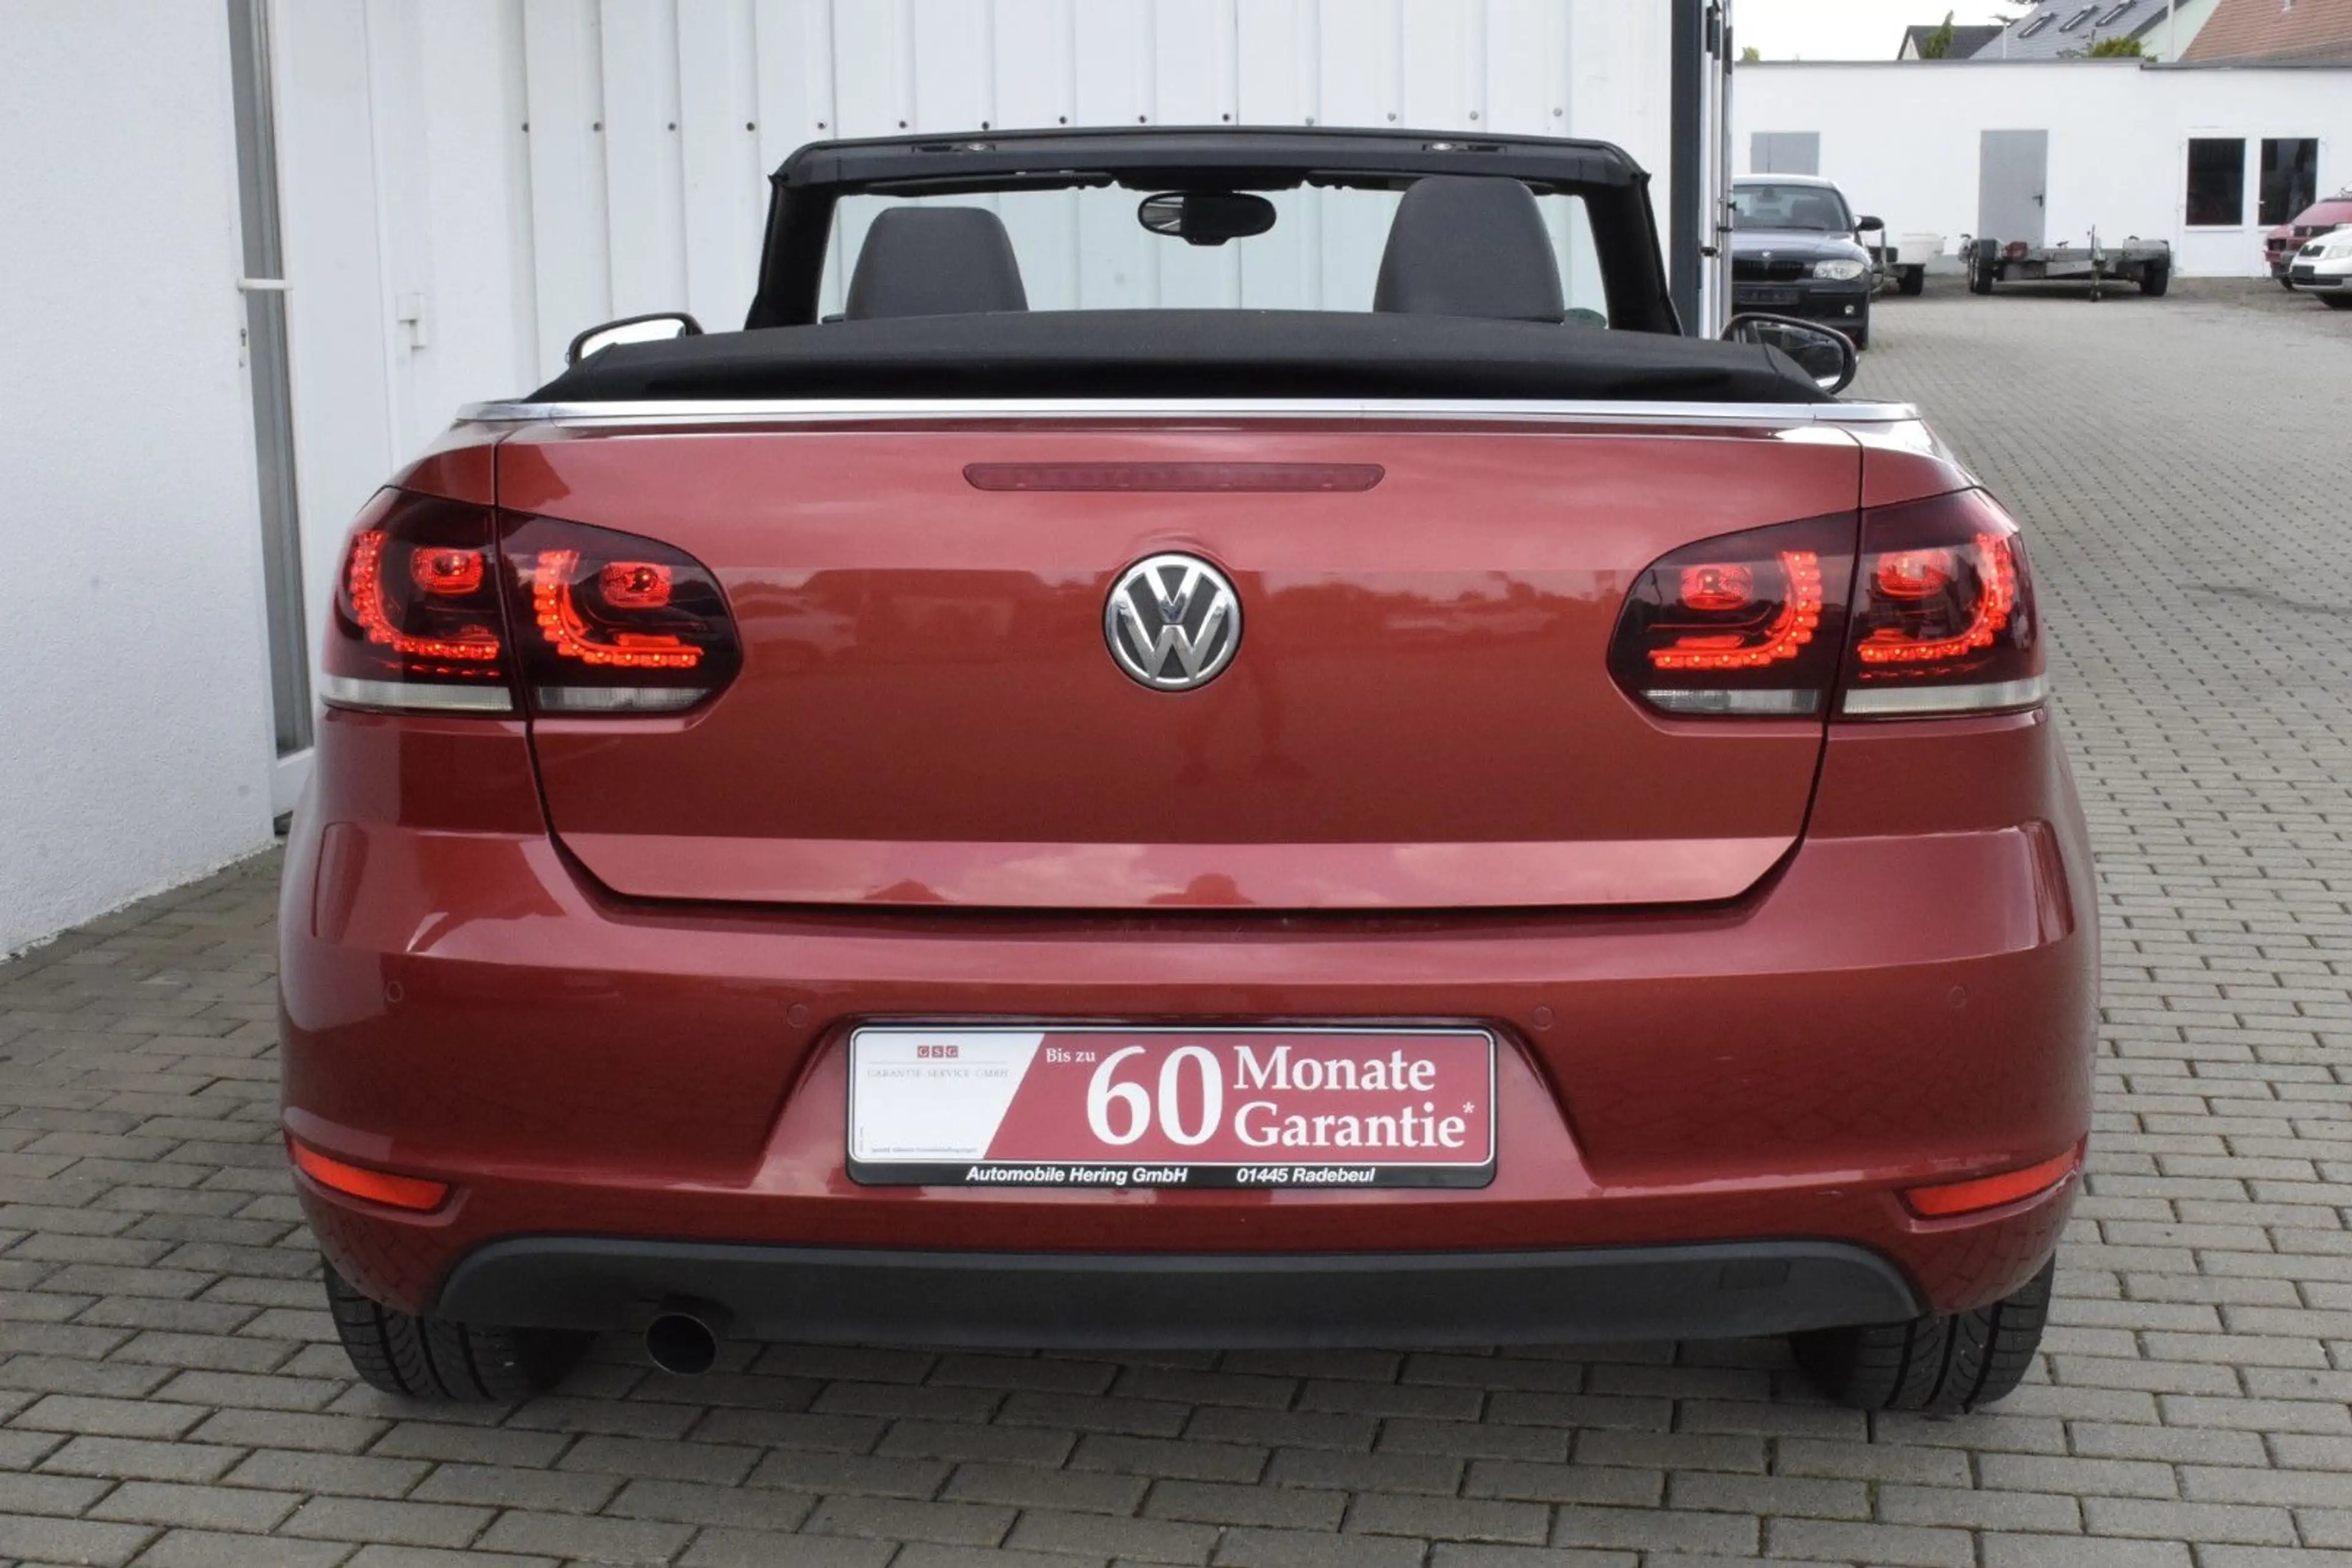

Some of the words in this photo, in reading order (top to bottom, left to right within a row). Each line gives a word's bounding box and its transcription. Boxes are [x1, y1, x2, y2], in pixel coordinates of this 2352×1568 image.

[1112, 556, 1232, 686] VW
[1046, 1048, 1071, 1063] Bis
[1076, 1051, 1096, 1063] zu
[1234, 1046, 1436, 1091] Monate
[1086, 1046, 1223, 1145] 60
[965, 1166, 1065, 1182] Automobile
[1069, 1166, 1128, 1185] Hering
[1132, 1167, 1188, 1183] GmbH
[1236, 1167, 1288, 1183] 01445
[1292, 1167, 1375, 1183] Radebeul
